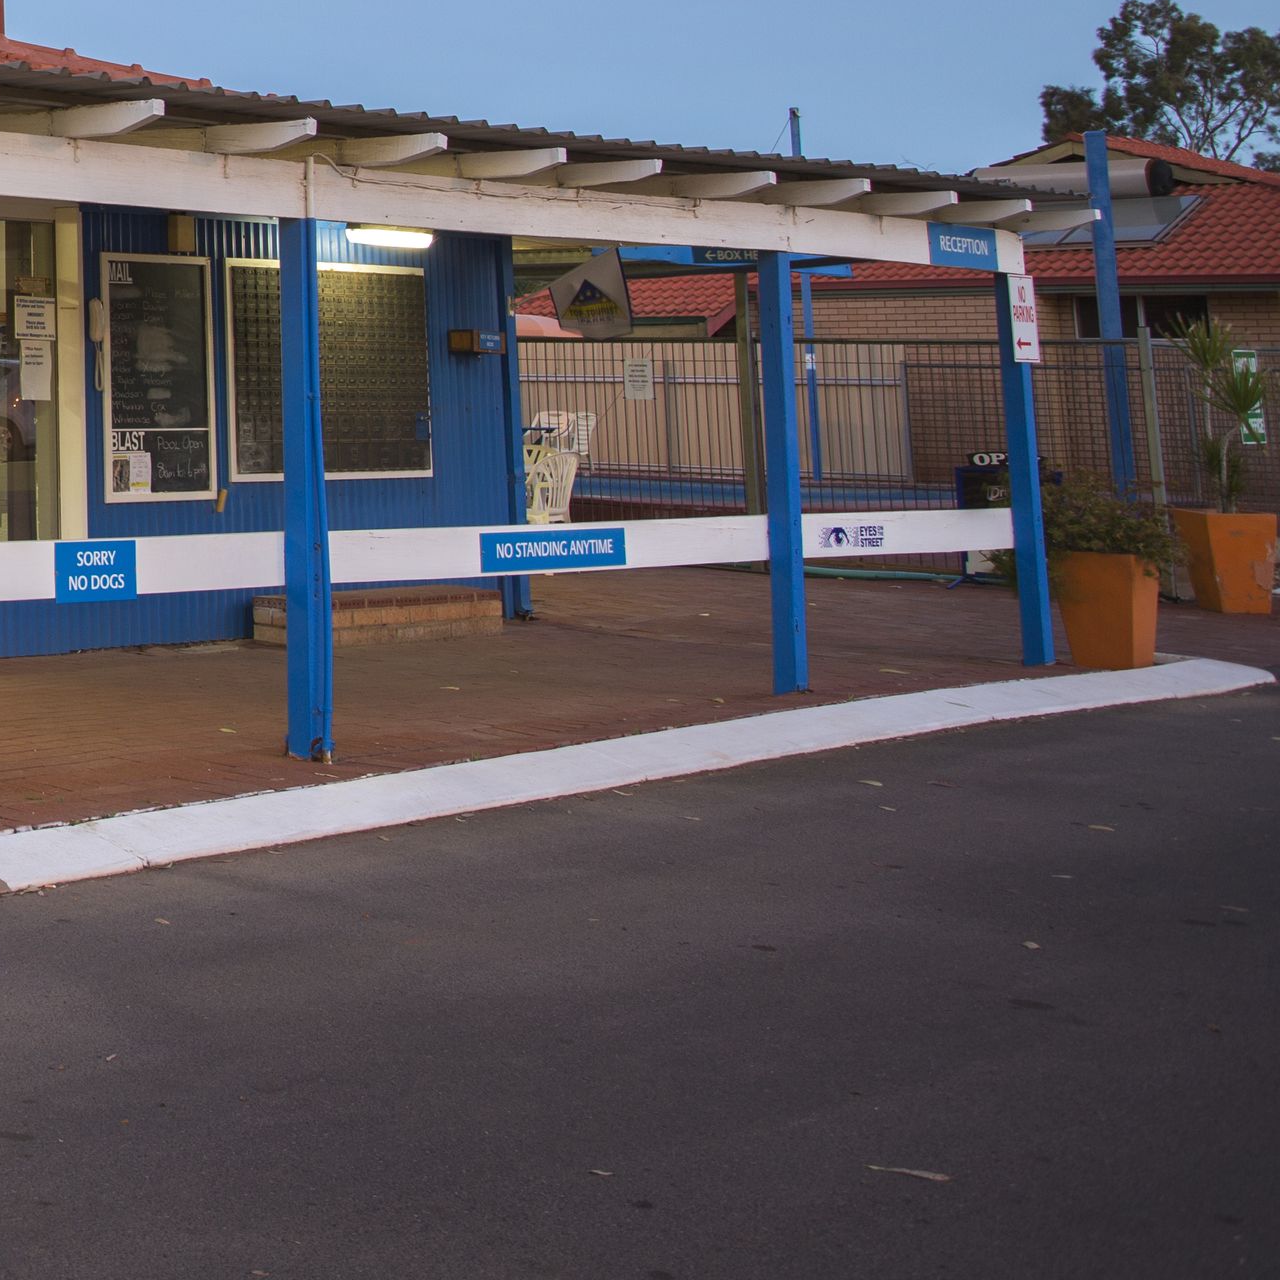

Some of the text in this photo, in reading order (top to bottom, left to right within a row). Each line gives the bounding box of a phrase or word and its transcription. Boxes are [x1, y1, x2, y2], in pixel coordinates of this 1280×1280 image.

[940, 235, 989, 255] RECEPTION
[717, 250, 759, 260] BOX HE
[108, 262, 133, 281] MAIL
[1017, 286, 1026, 303] NO
[1012, 305, 1034, 323] PARKING
[112, 431, 145, 451] BLAST
[860, 525, 877, 536] EYES
[496, 538, 614, 559] NO STANDING ANYTIME
[860, 537, 884, 547] STREET
[76, 550, 116, 567] SORRY
[68, 573, 125, 591] NO DOGS
